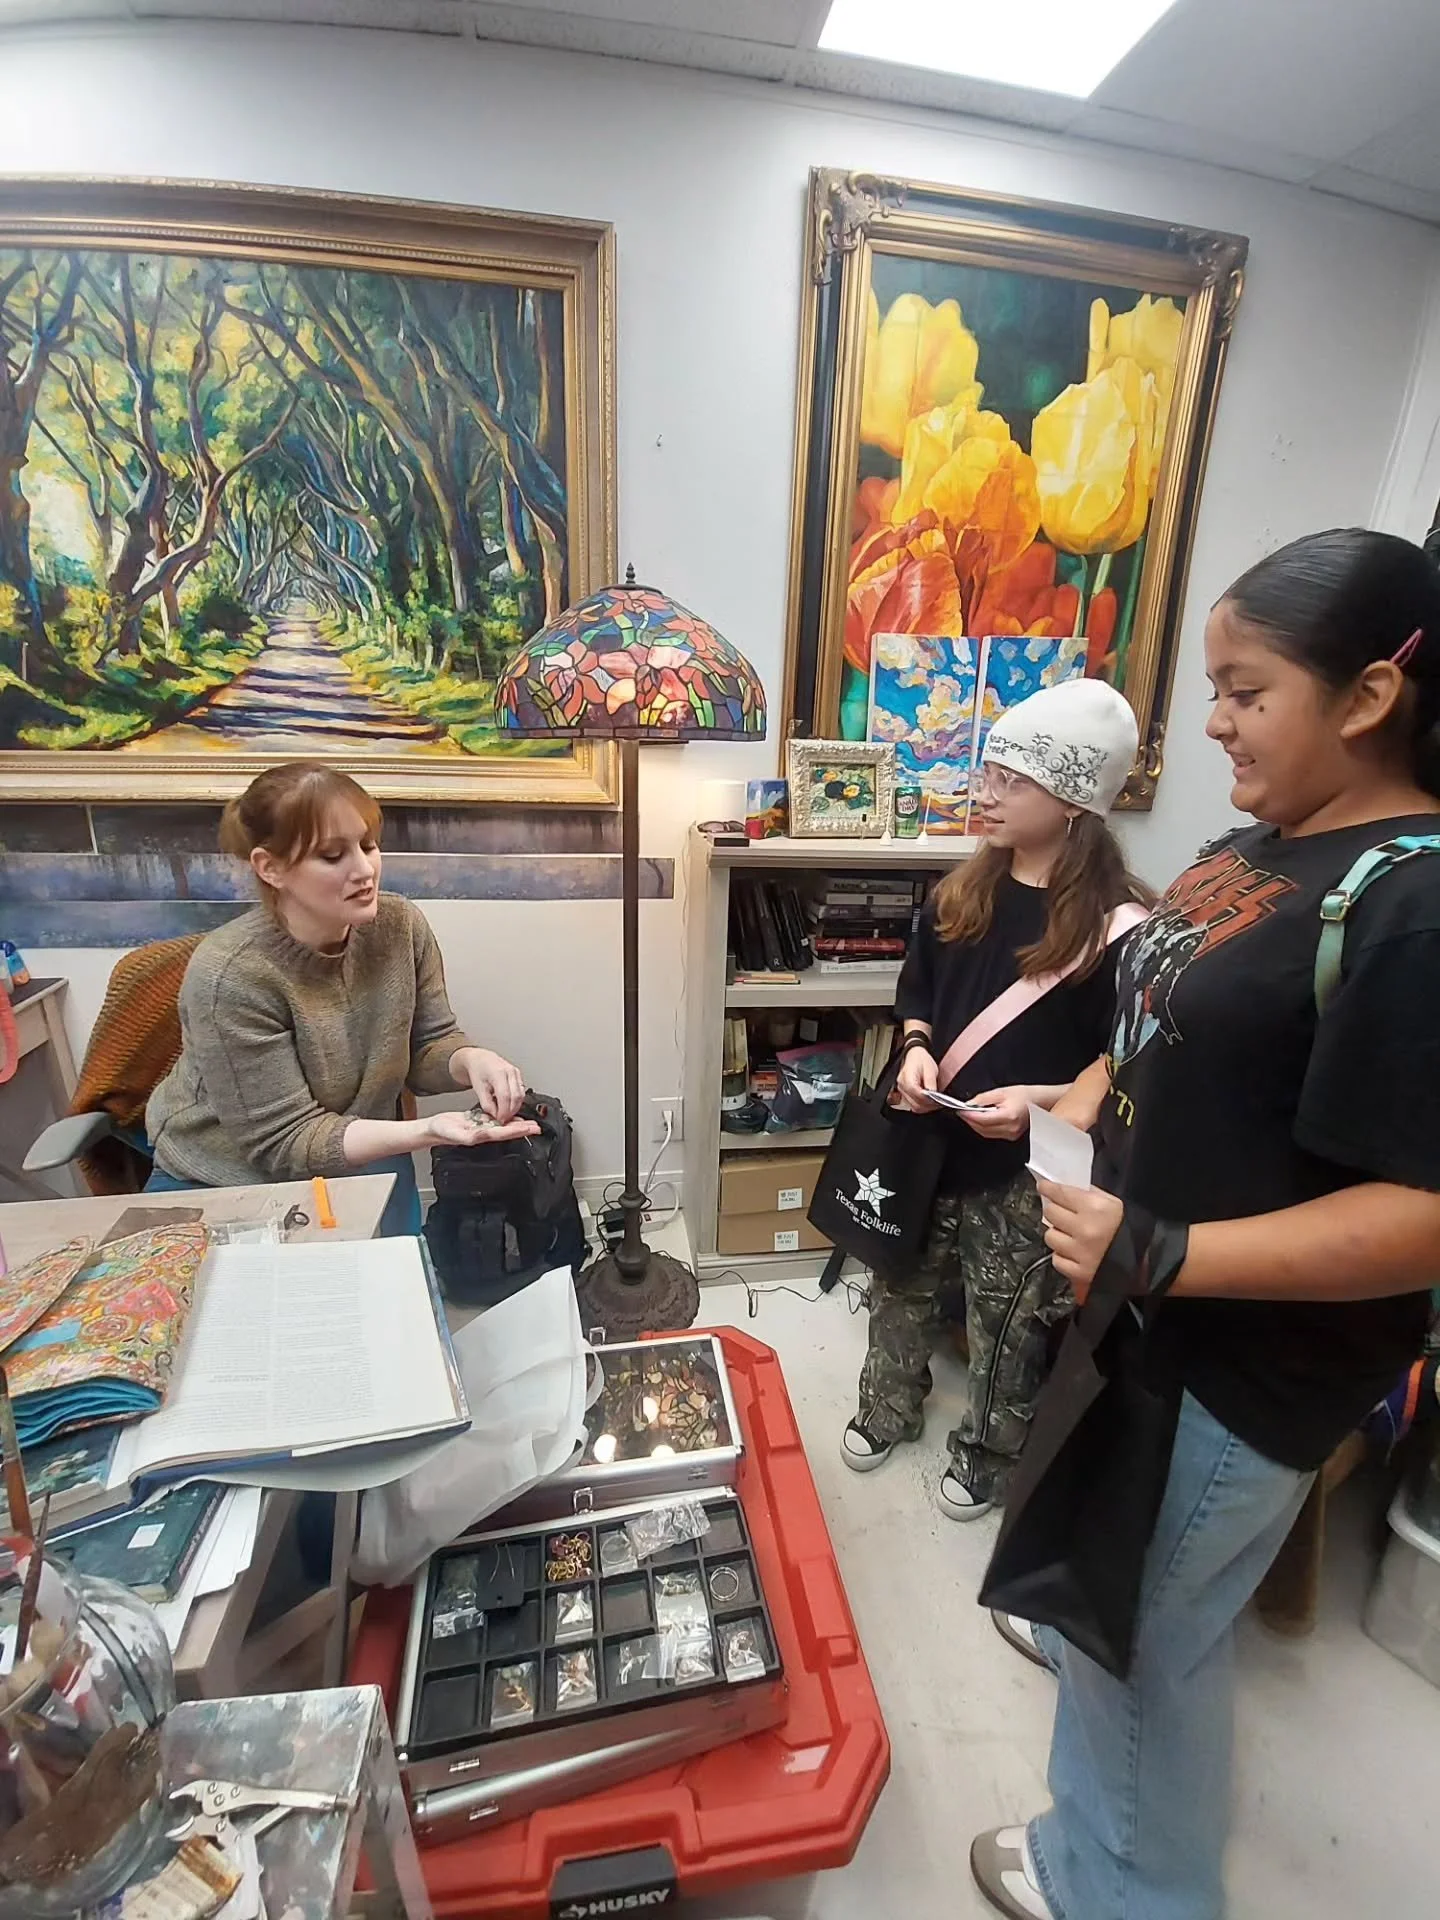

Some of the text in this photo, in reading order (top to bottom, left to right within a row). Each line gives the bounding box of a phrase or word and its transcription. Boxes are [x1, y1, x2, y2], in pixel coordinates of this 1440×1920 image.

[835, 1187, 902, 1237] Texas Folklife
[588, 1887, 671, 1916] HUSKY
